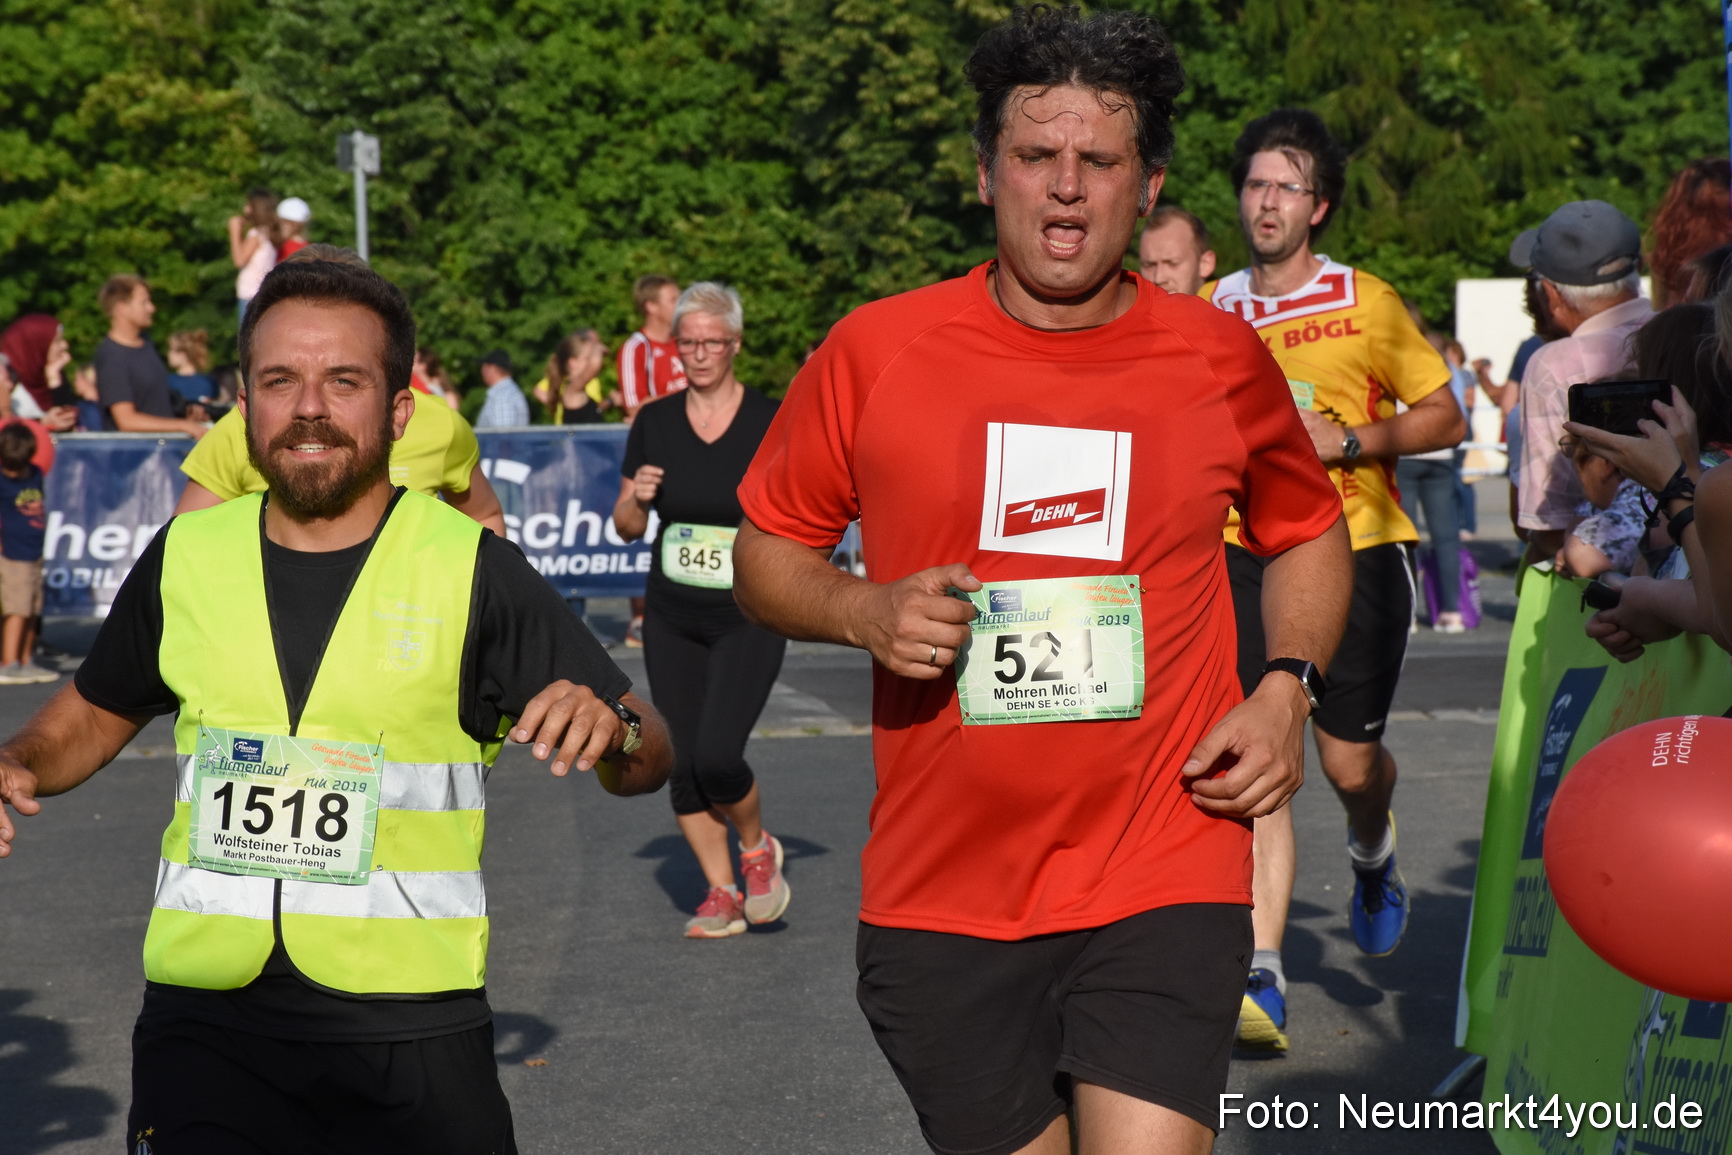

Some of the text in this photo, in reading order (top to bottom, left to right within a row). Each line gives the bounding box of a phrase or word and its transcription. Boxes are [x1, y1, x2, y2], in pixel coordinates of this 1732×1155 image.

[1283, 318, 1361, 349] BÖGL
[1030, 502, 1078, 523] DEHN
[679, 547, 722, 570] 845
[977, 607, 1052, 625] firmenlauf
[1097, 614, 1130, 626] 2019
[994, 629, 1094, 685] 521
[994, 687, 1047, 699] Mohren
[1007, 701, 1035, 710] DEHN
[1038, 700, 1051, 708] SE
[1063, 699, 1076, 707] Co
[1652, 732, 1672, 767] DEHN
[219, 770, 248, 778] neumarkt
[220, 757, 290, 776] firmenlauf
[332, 780, 367, 792] 2019
[213, 781, 349, 842] 1518
[214, 833, 341, 858] Wolfsteiner Tobias
[223, 849, 247, 860] Markt
[249, 853, 326, 869] Postbauer-Heng
